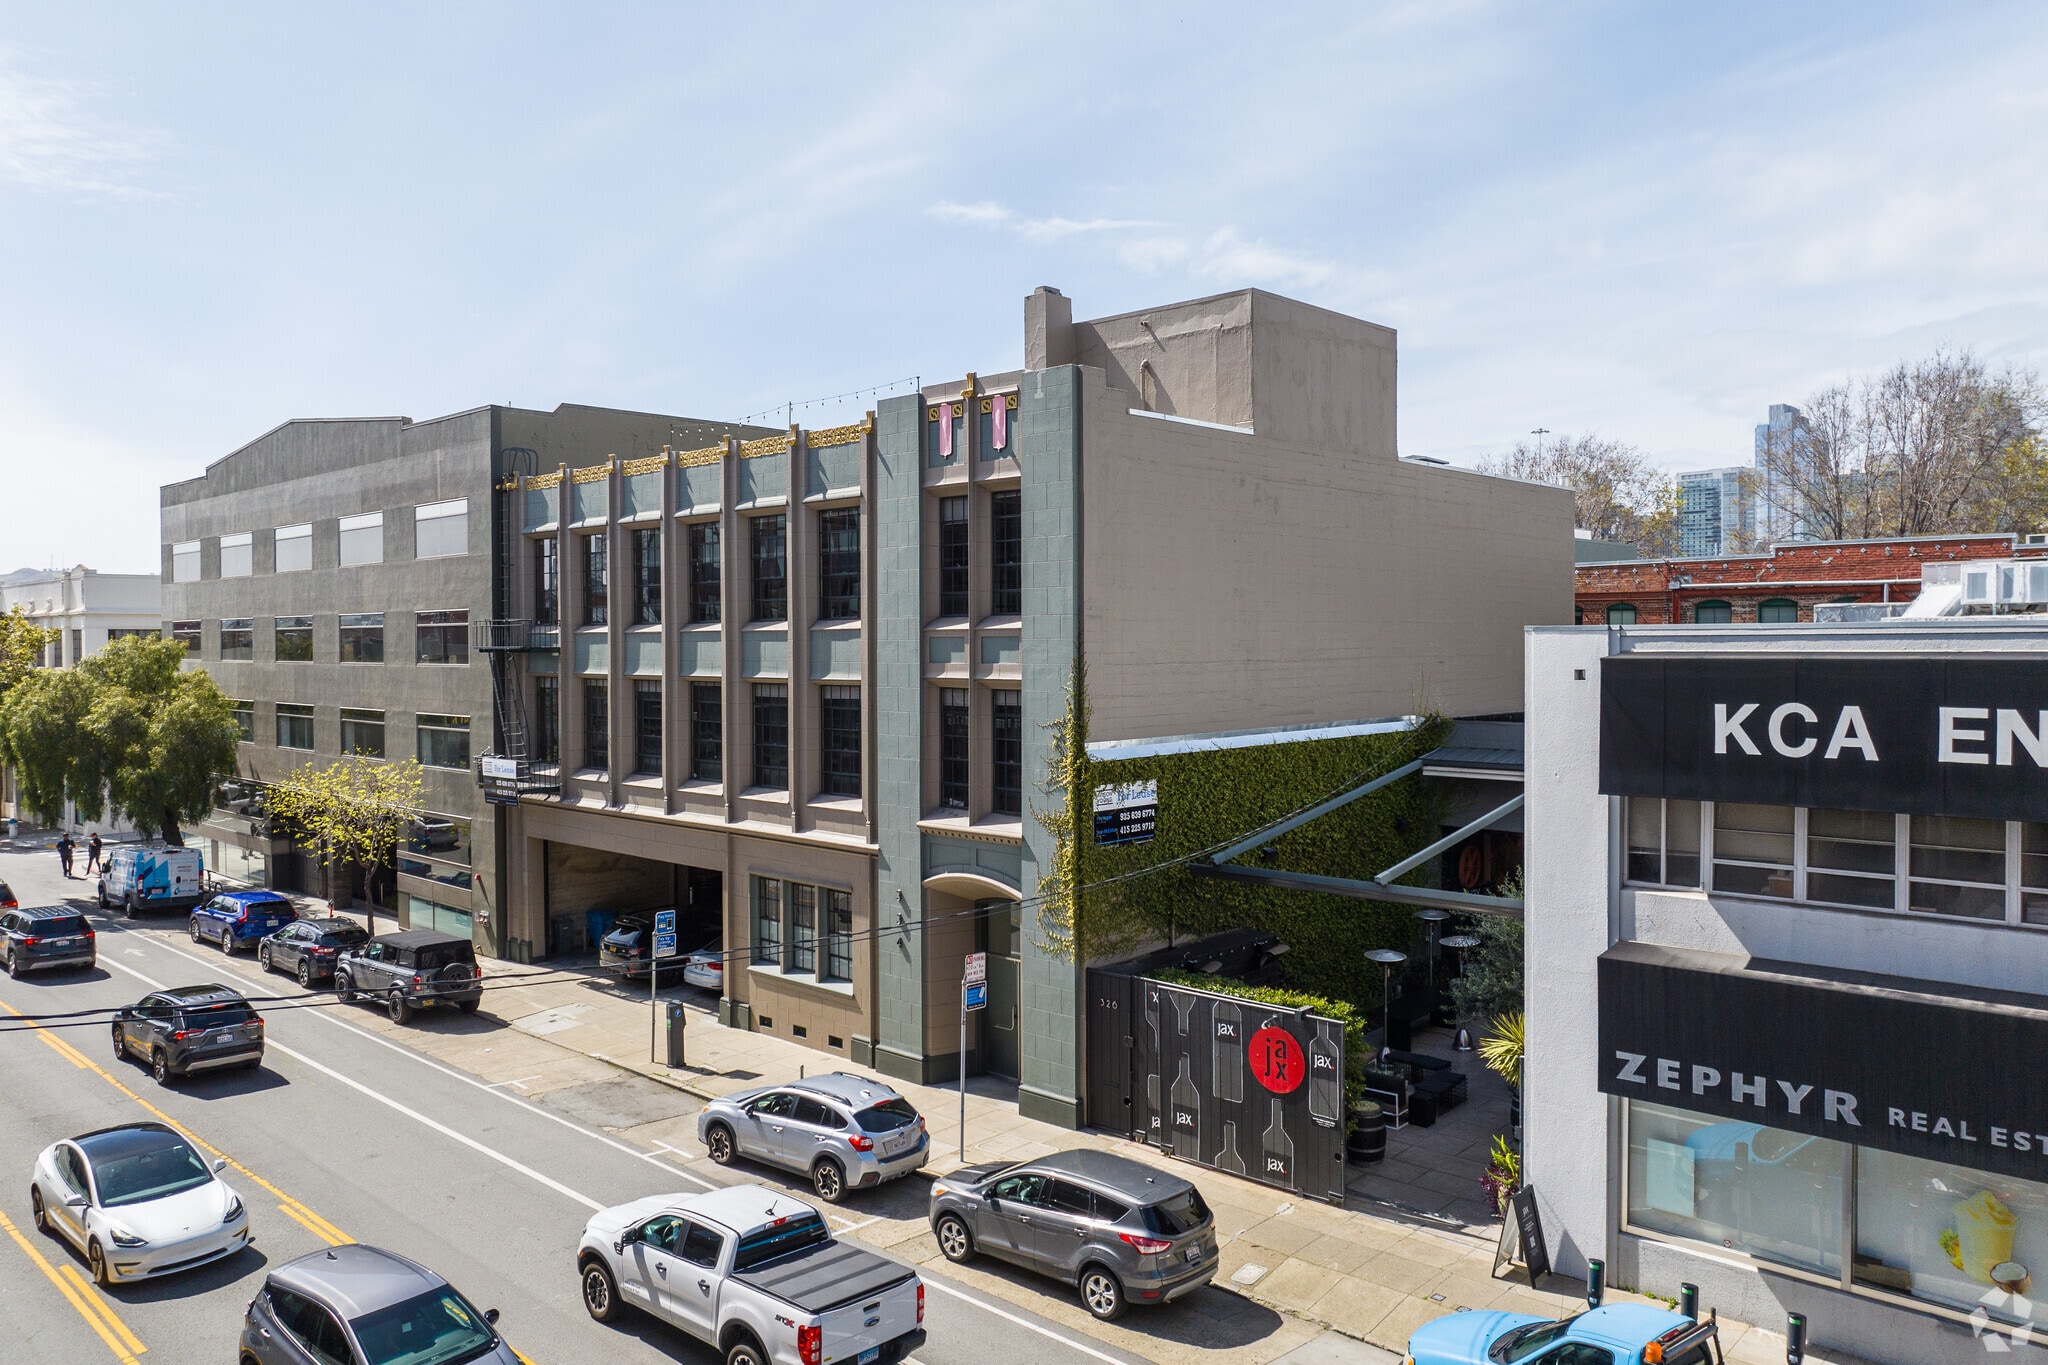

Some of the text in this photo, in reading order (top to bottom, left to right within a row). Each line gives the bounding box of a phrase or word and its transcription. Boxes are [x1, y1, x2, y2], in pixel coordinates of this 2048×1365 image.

[1714, 702, 2048, 769] KCA EN
[1132, 789, 1156, 801] Lease
[1120, 812, 1130, 821] 925
[1131, 810, 1141, 820] 639
[1142, 809, 1155, 818] 6774
[1120, 825, 1130, 834] 415
[1131, 823, 1141, 833] 225
[1100, 998, 1118, 1010] 326
[1615, 1050, 1862, 1127] ZEPHYR
[1888, 1107, 1977, 1142] REAL
